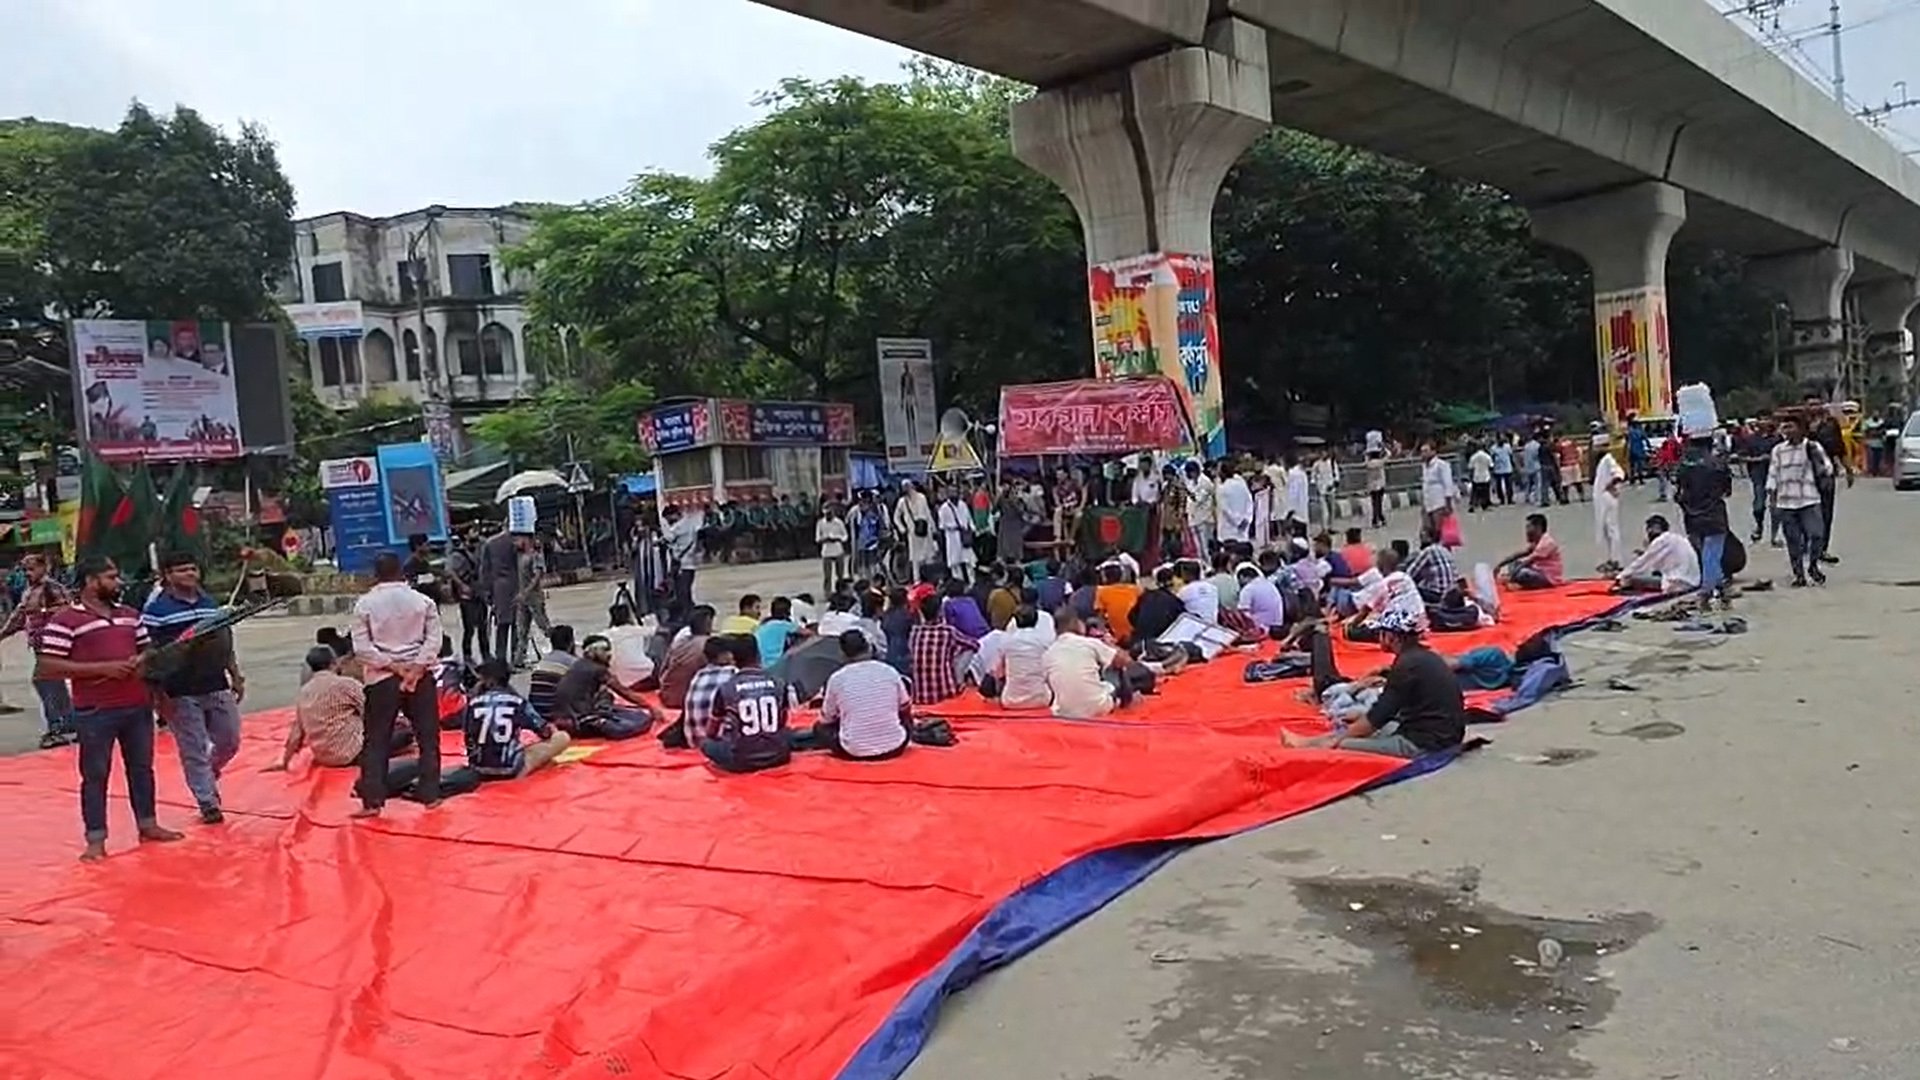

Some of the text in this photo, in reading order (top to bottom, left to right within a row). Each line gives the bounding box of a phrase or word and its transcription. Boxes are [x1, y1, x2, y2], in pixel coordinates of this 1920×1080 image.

[1009, 404, 1102, 433] অবস্থান
[474, 706, 515, 744] 75
[738, 695, 779, 735] 90
